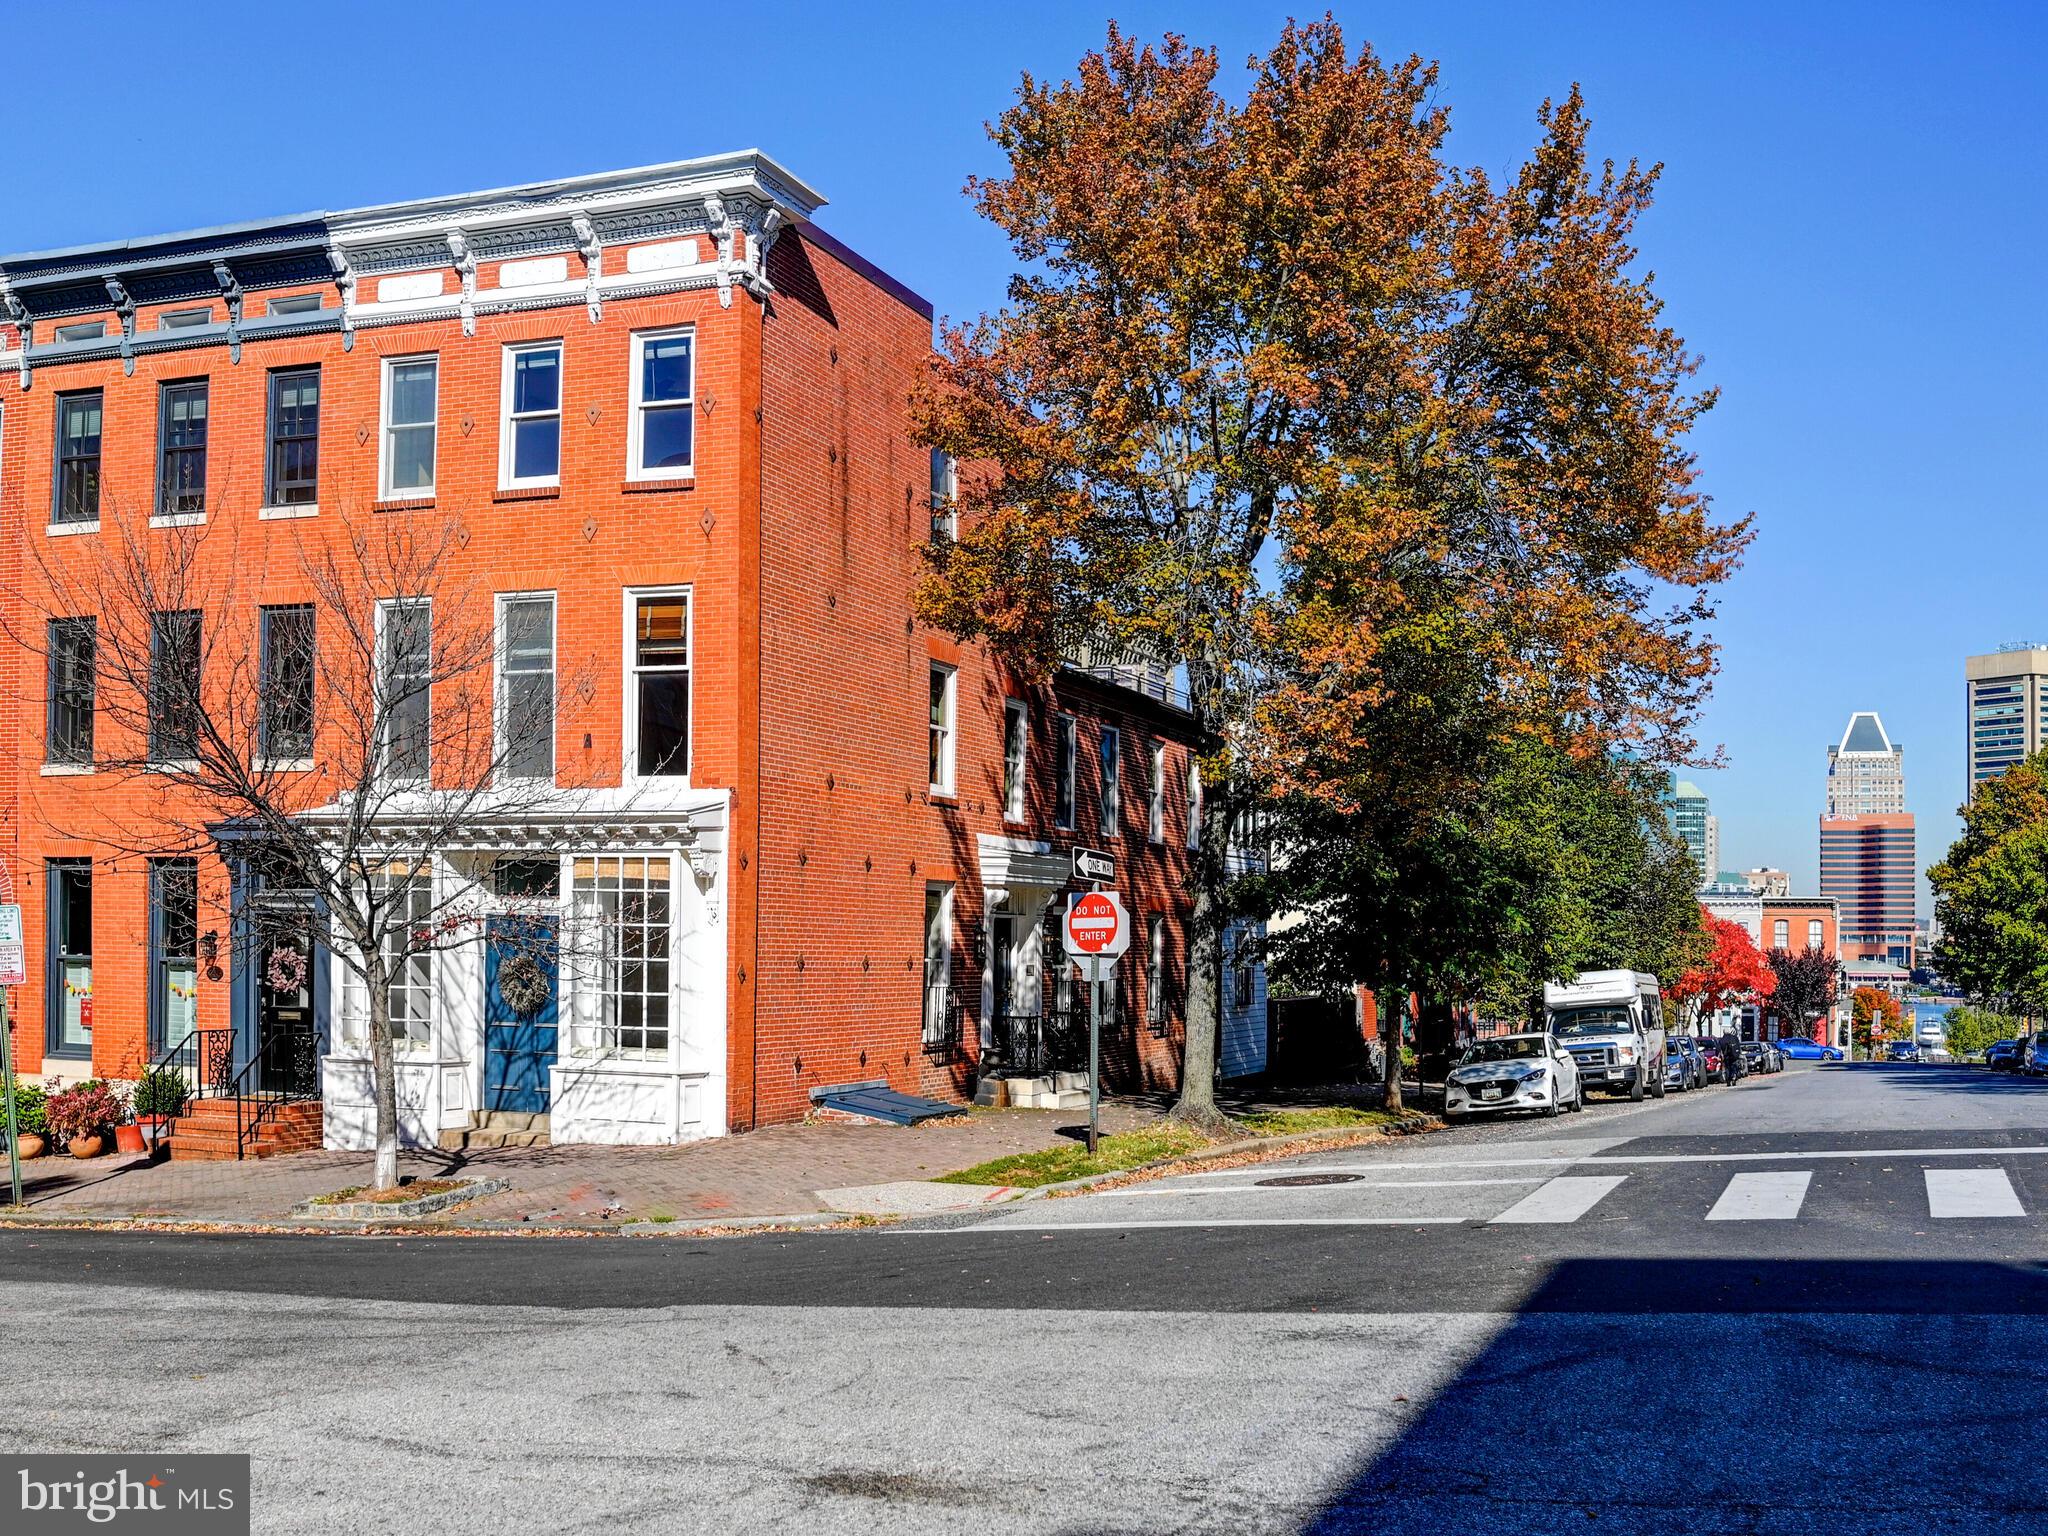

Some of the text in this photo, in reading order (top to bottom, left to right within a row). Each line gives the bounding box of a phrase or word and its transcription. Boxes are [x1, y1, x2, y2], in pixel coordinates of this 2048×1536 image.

[1088, 859, 1113, 875] ONE WAY
[1076, 905, 1110, 915] DO NOT
[1080, 931, 1106, 940] ENTER
